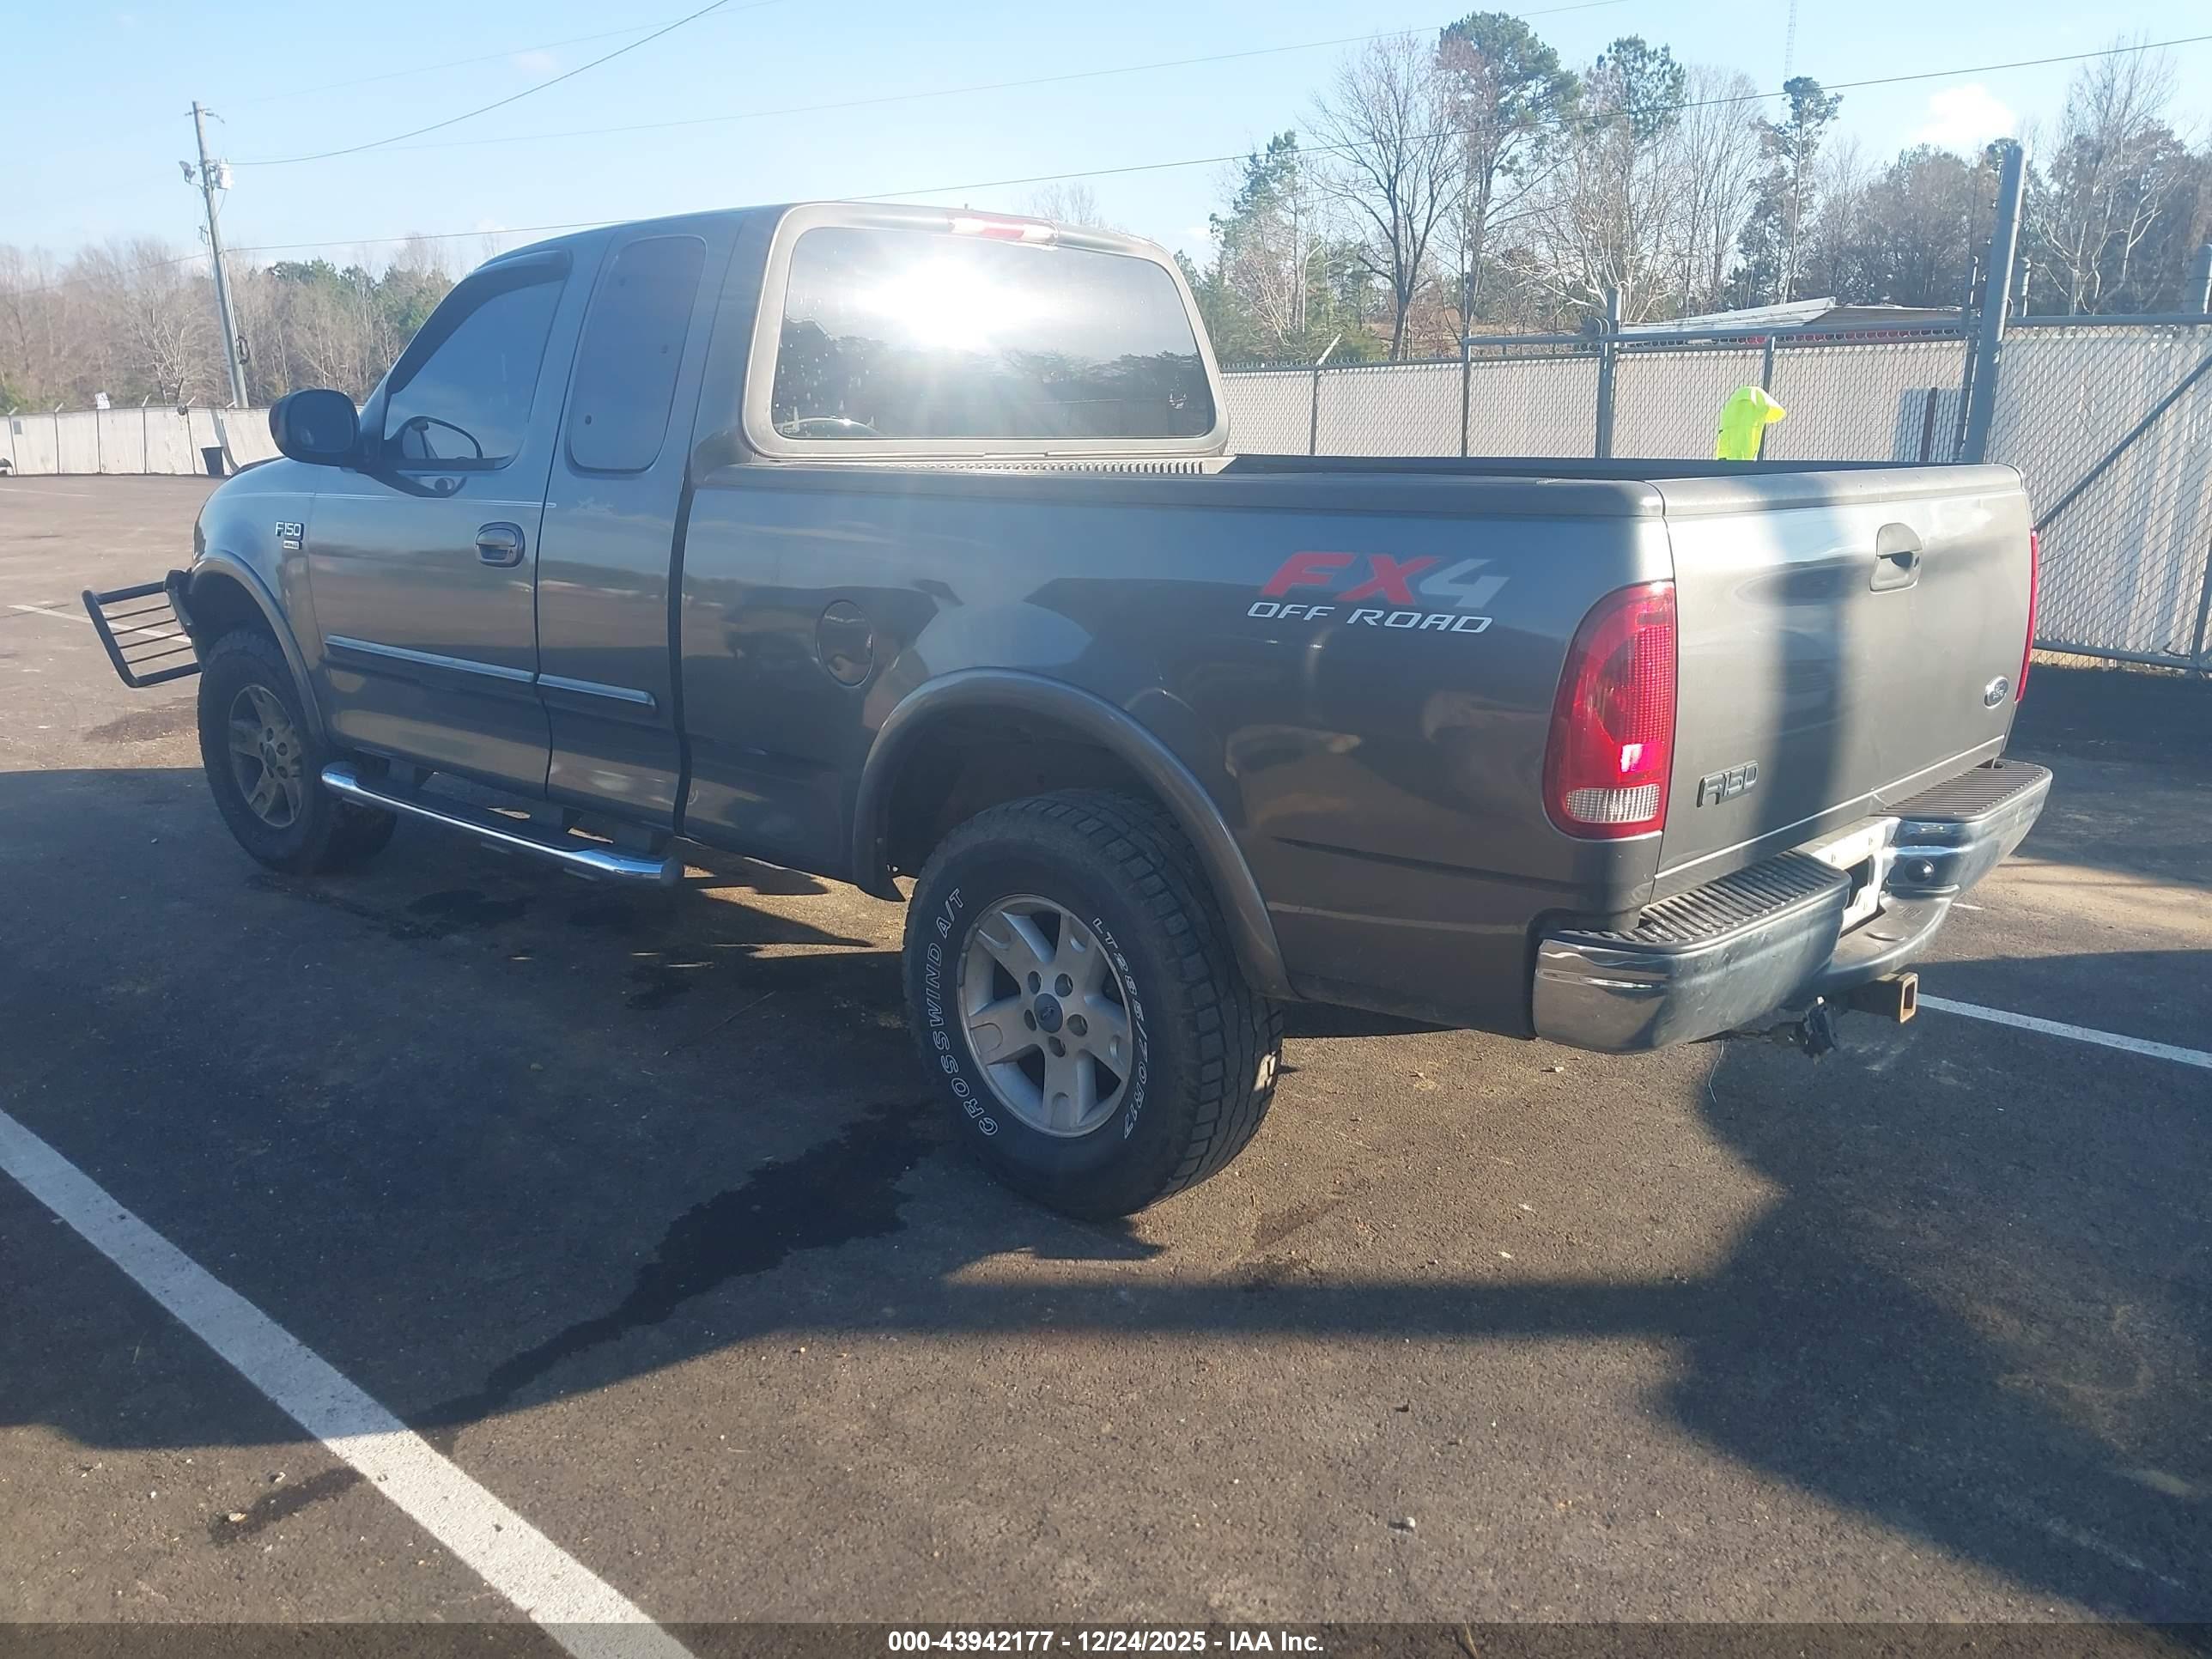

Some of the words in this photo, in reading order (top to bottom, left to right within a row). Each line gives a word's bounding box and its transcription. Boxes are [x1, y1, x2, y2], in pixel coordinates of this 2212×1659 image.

[275, 521, 301, 537] F150
[1261, 550, 1510, 608] FX4
[1247, 601, 1335, 620] OFF
[1346, 608, 1492, 633] ROAD
[936, 888, 964, 939] A/T
[926, 942, 998, 1135] CROSSWIND
